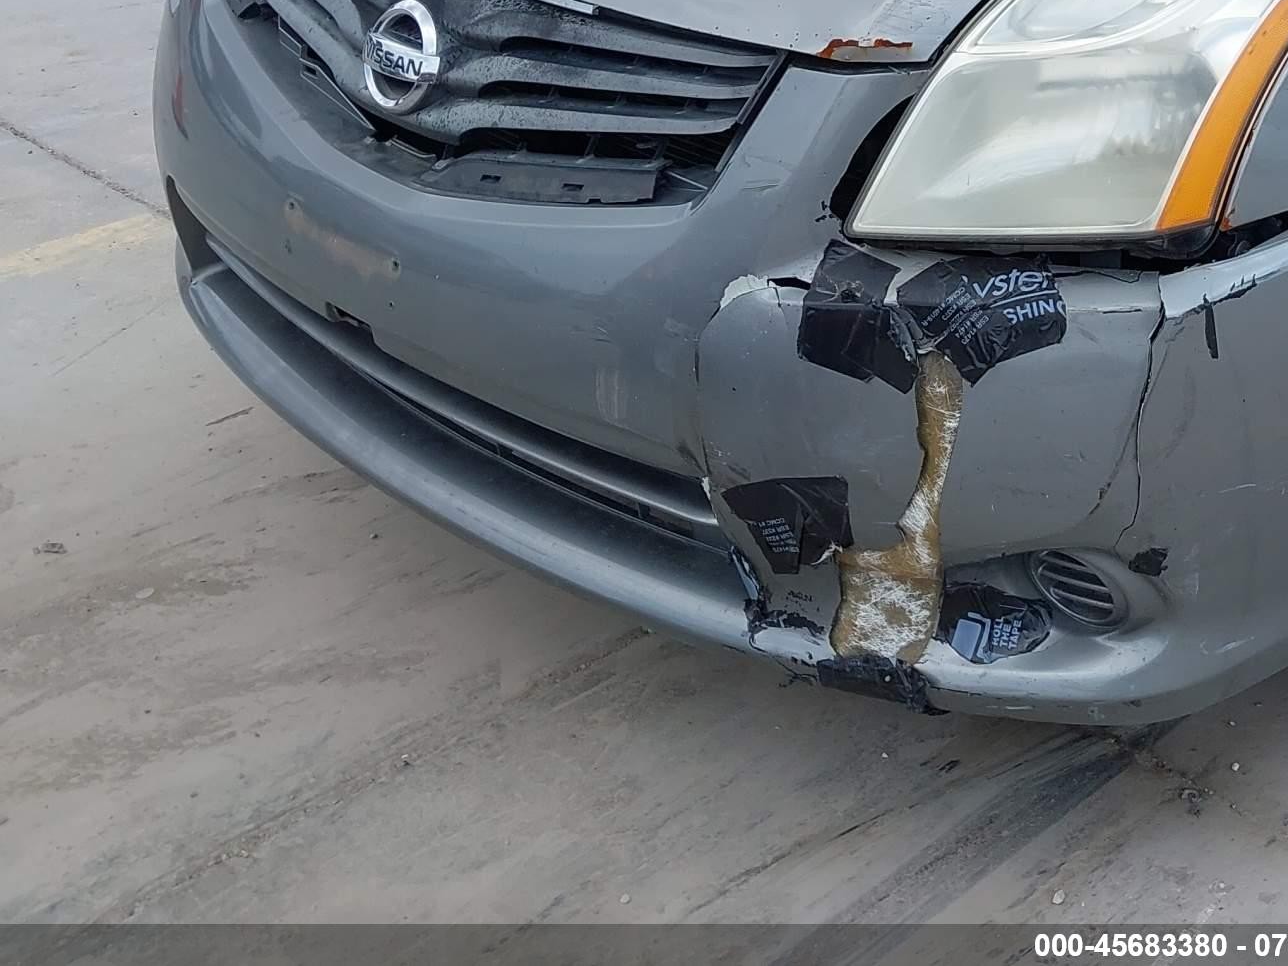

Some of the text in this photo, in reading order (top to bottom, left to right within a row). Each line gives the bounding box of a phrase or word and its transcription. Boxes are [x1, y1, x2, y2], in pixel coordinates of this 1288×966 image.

[366, 36, 424, 77] NISSAN
[999, 623, 1013, 648] THE
[1007, 619, 1023, 651] TAPE
